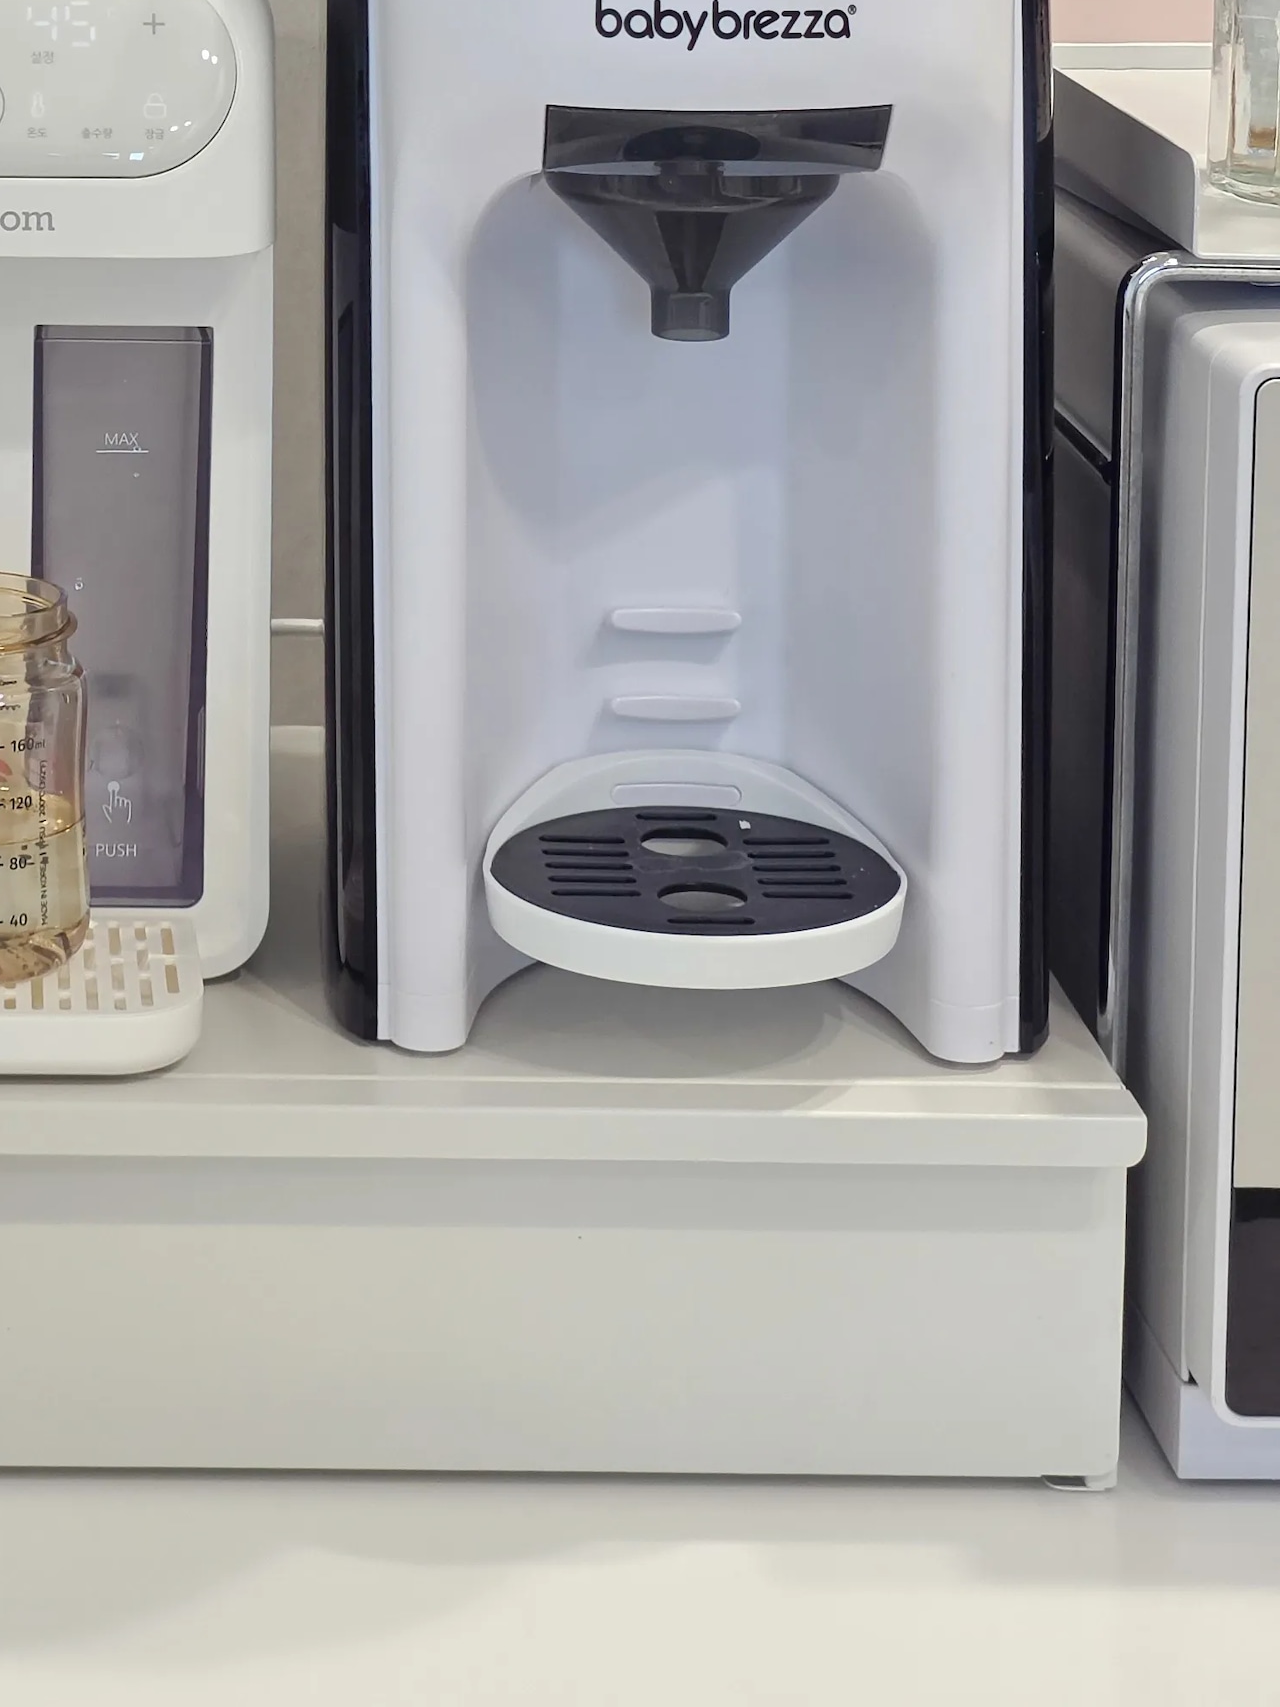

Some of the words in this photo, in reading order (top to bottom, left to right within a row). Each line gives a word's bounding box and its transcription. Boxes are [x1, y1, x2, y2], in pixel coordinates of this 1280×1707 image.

[26, 0, 96, 47] 45
[30, 50, 55, 65] 설정
[26, 126, 48, 139] 온도
[144, 128, 165, 141] 잠금
[104, 432, 139, 446] MAX
[9, 795, 33, 810] 120
[95, 843, 137, 857] PUSH
[9, 856, 28, 871] 80
[9, 912, 29, 927] 40
[39, 901, 49, 926] MADE
